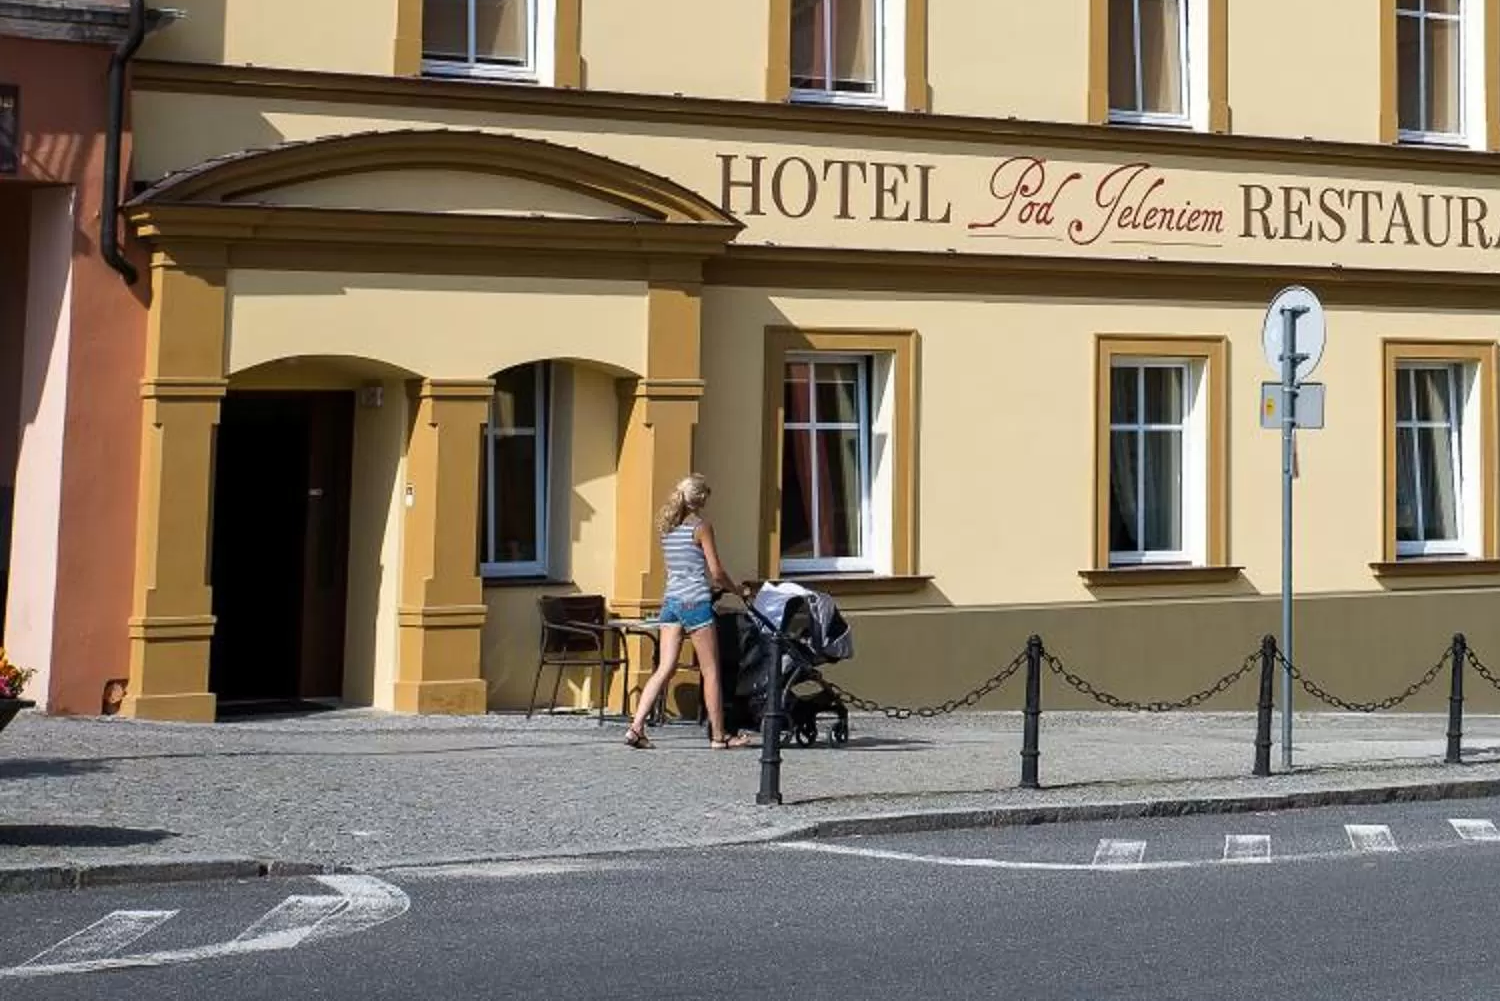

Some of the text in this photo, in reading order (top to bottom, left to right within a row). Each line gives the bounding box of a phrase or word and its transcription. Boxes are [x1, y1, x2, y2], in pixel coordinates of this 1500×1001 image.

[716, 153, 951, 224] HOTEL
[968, 156, 1083, 229] Pod
[1069, 162, 1224, 246] Jeleniem
